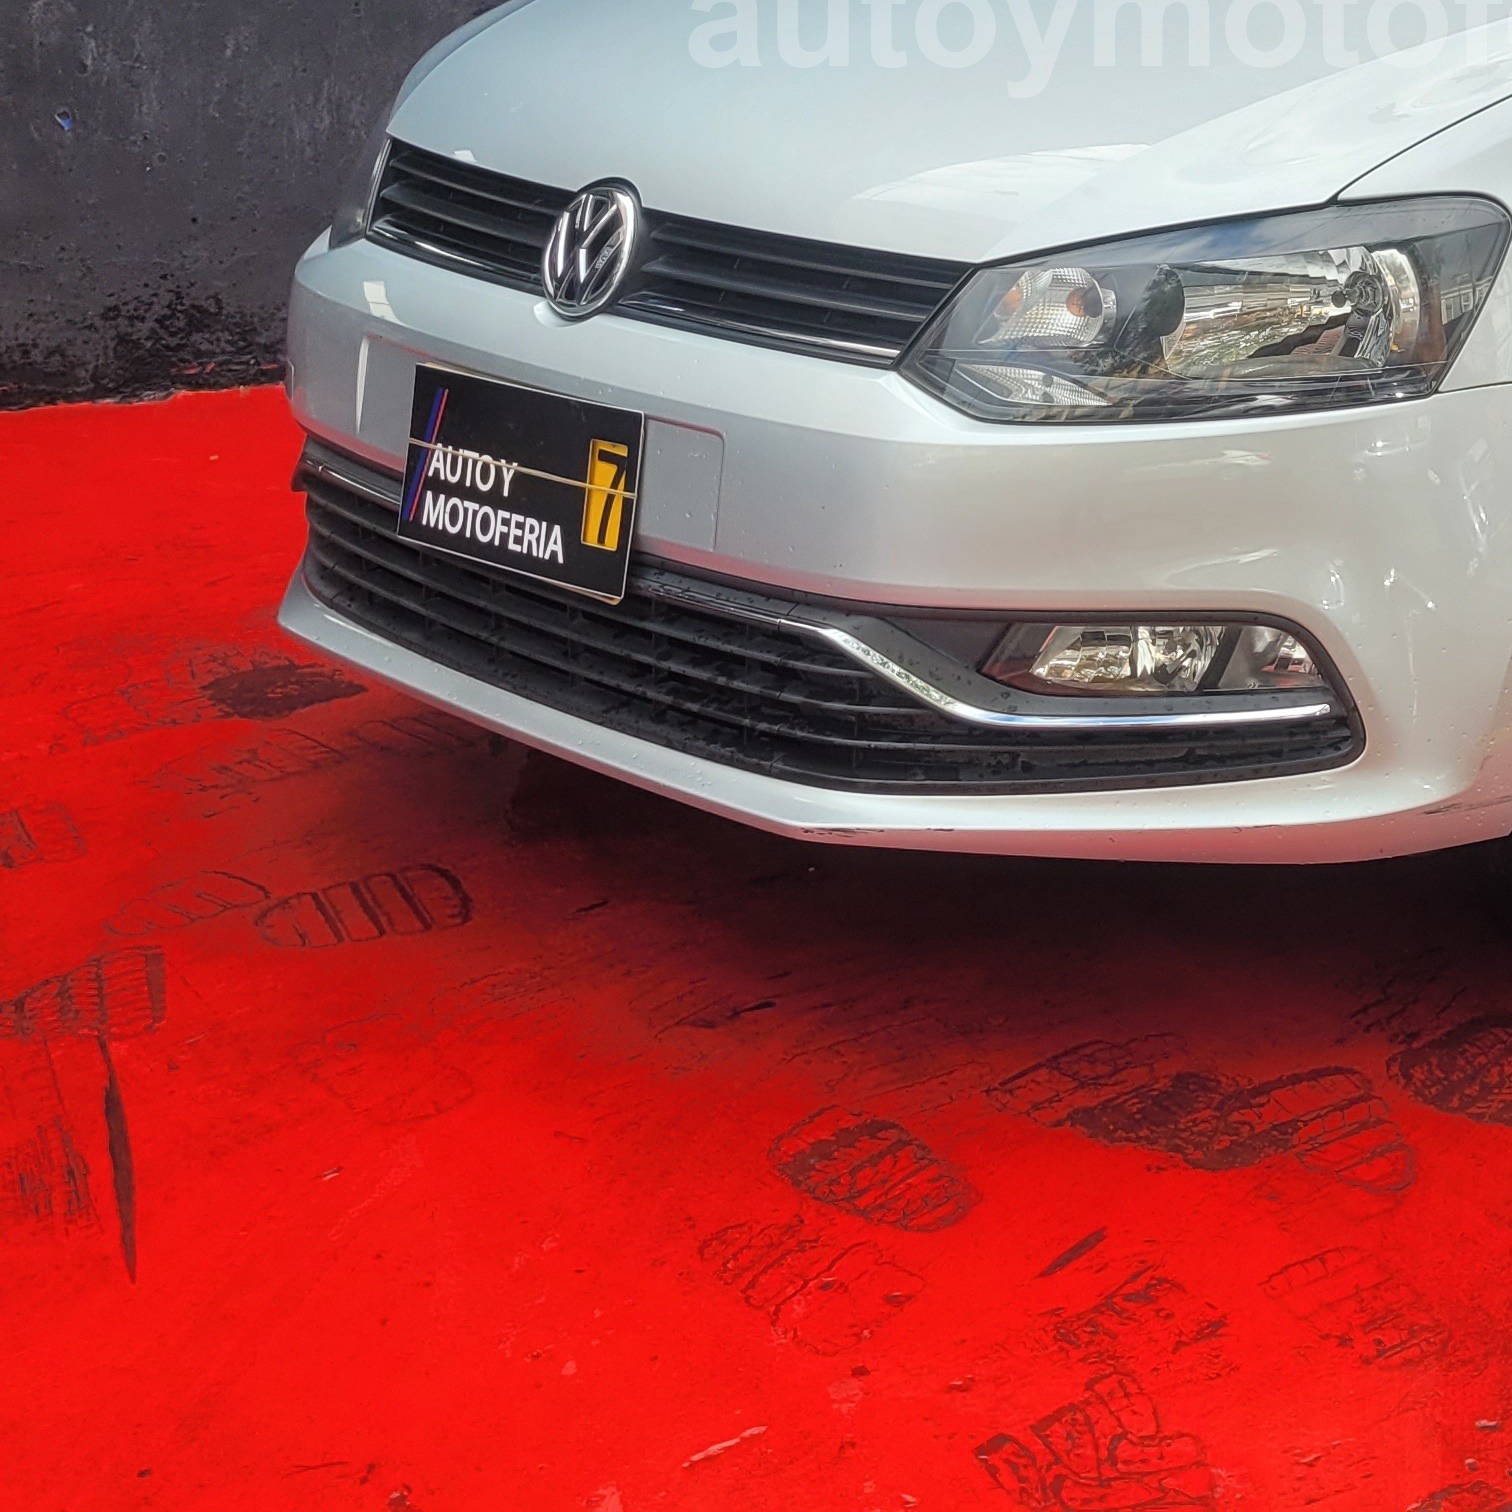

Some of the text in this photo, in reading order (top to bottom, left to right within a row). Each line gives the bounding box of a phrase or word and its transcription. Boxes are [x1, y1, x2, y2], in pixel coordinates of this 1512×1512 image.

[428, 442, 518, 497] AUTO Y
[421, 490, 564, 564] MOTOFERIA
